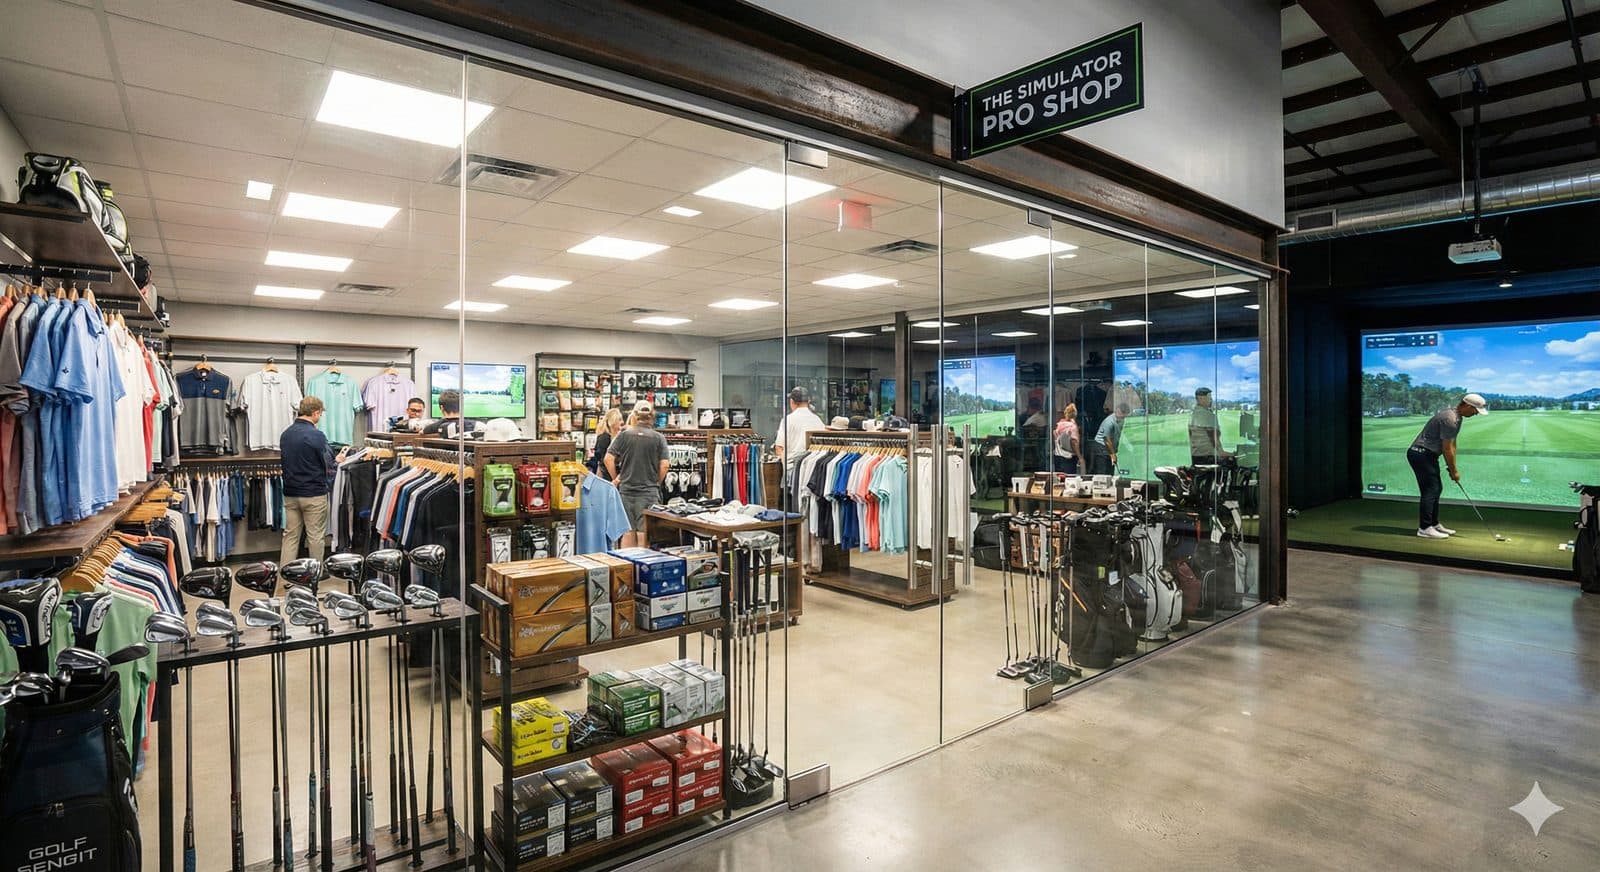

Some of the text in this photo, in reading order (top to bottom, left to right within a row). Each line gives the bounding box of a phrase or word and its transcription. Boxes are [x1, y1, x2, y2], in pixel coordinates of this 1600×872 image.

[982, 50, 1122, 112] THE SIMULATOR
[983, 72, 1123, 137] PRO SHOP
[28, 836, 88, 860] GOLF
